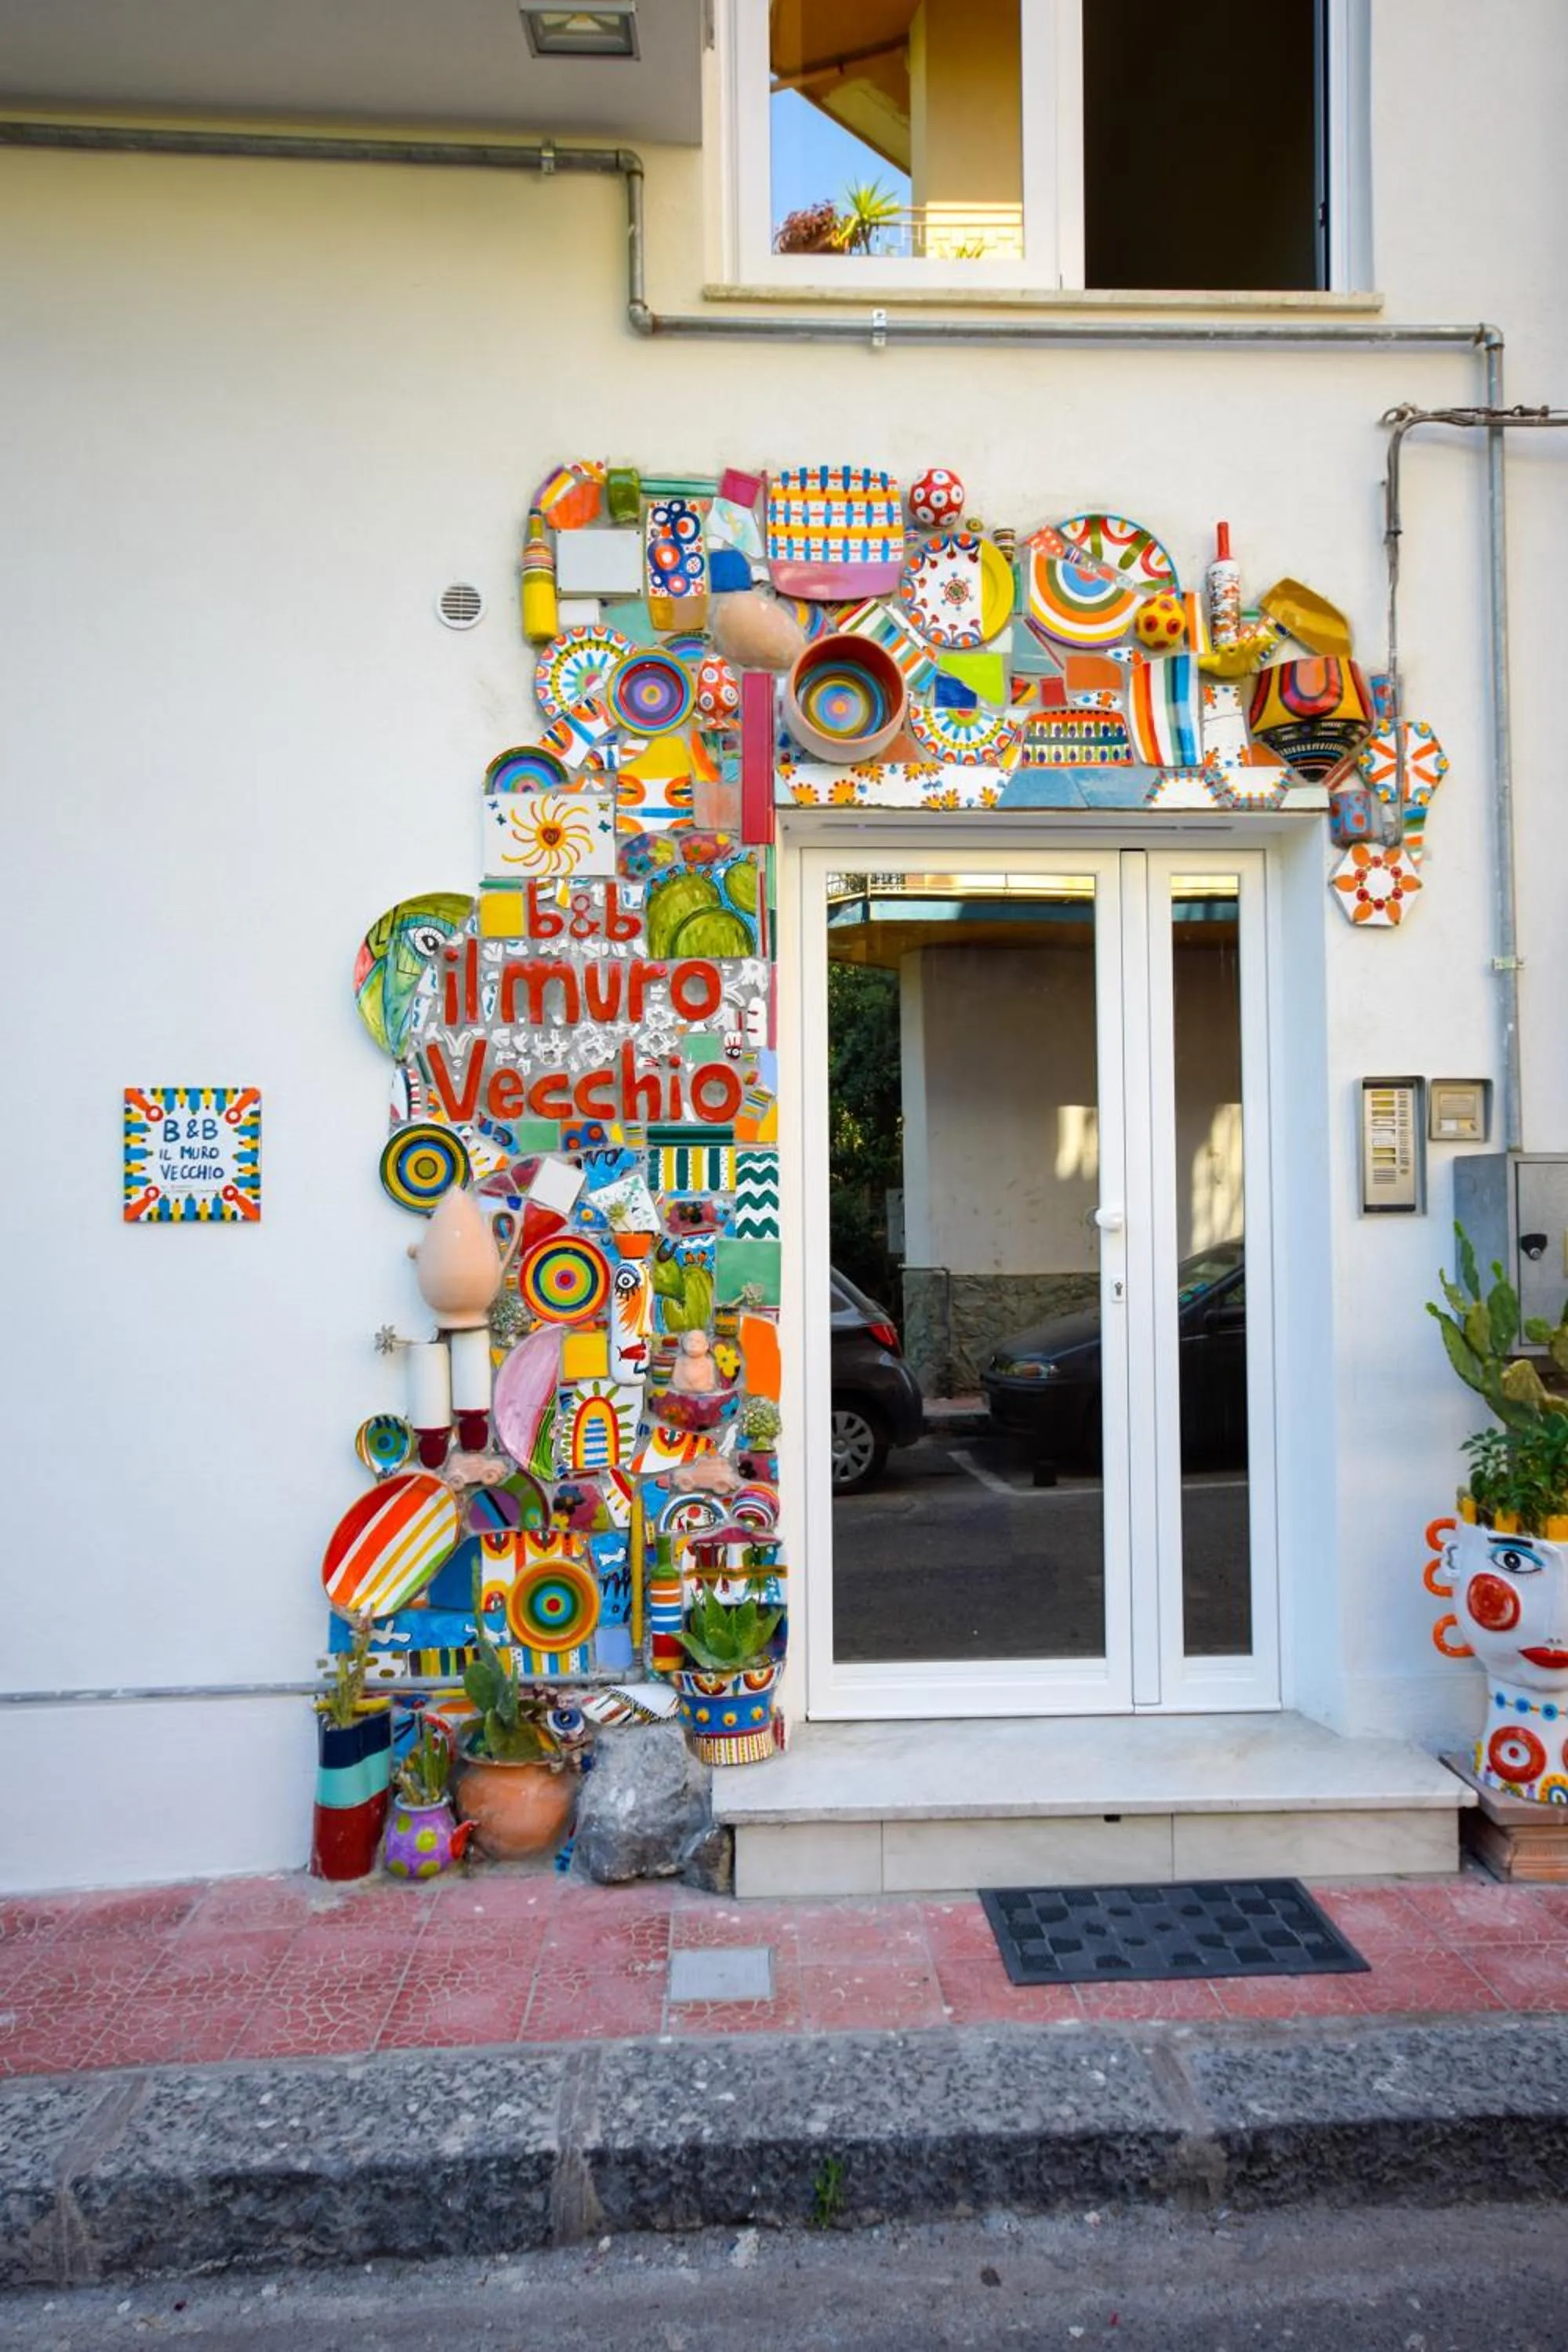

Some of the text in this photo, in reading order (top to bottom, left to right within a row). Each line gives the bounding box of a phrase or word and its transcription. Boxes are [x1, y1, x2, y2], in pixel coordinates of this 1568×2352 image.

[528, 882, 643, 942] b&b
[444, 938, 723, 1025] il muro
[425, 1039, 743, 1123] Vecchio
[162, 1118, 219, 1142] B&B
[159, 1145, 221, 1160] IL MURO
[160, 1163, 226, 1181] VECCHIO
